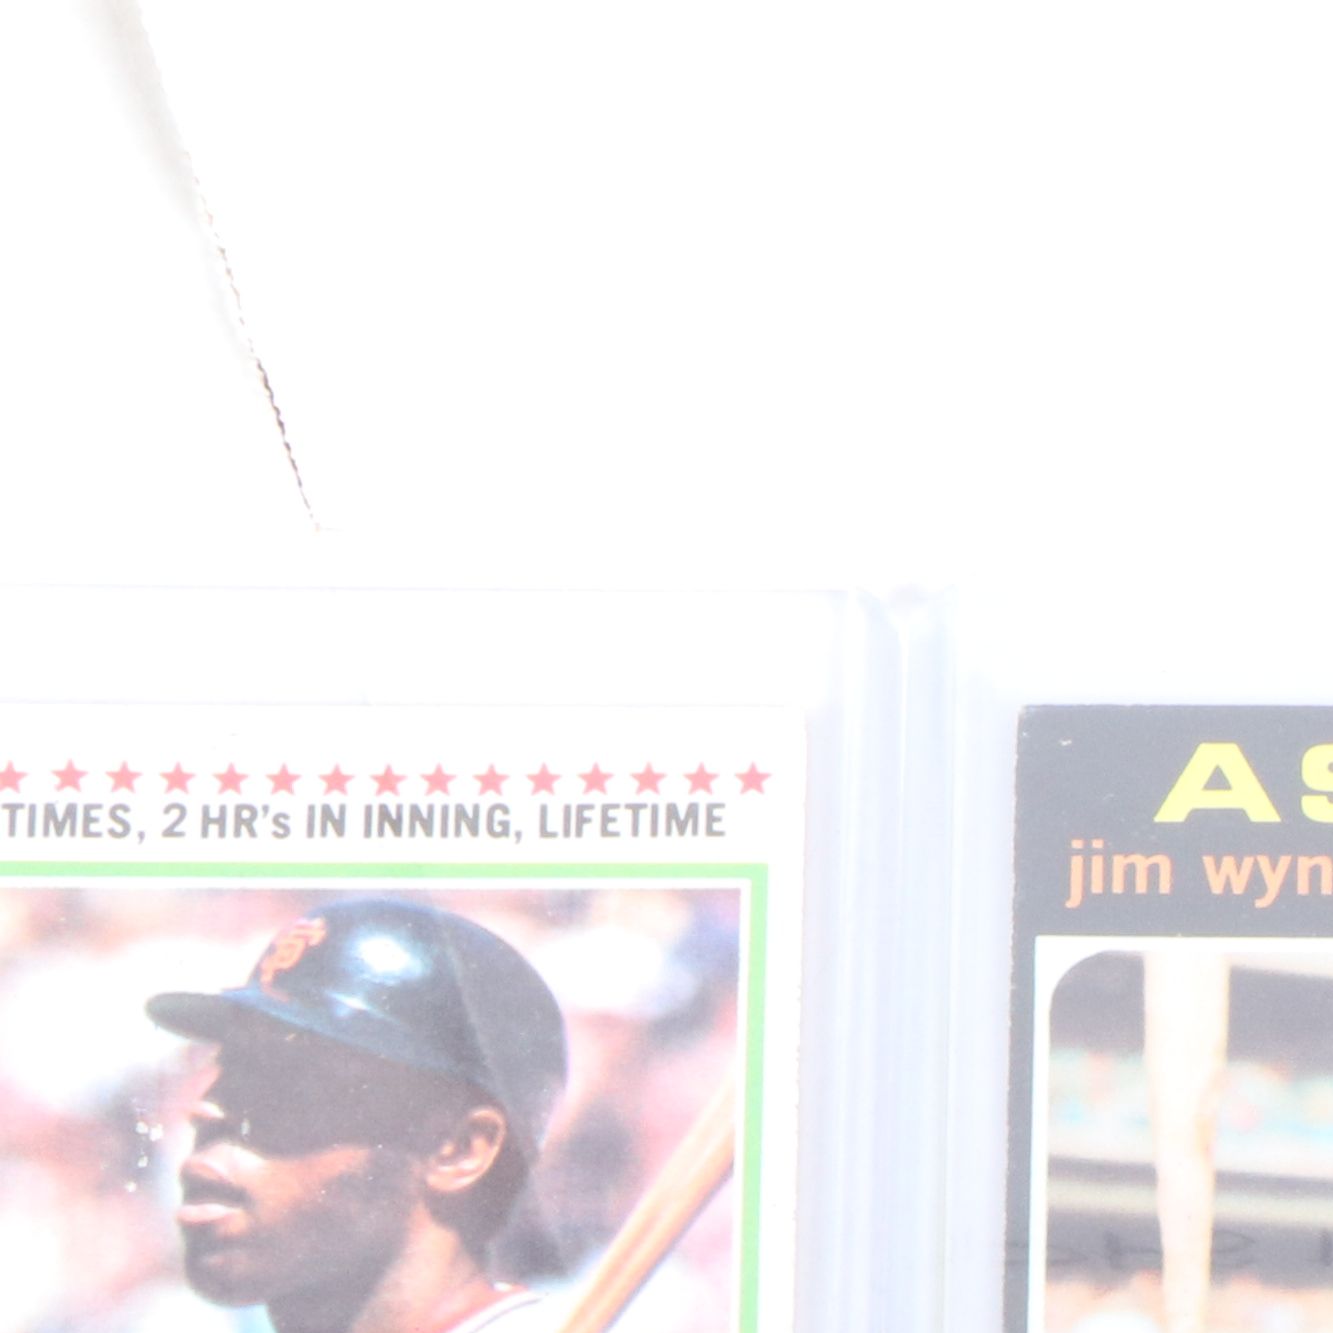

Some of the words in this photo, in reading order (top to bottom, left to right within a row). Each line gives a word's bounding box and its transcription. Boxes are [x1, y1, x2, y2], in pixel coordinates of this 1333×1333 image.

[1, 801, 147, 845] TIMES,
[161, 801, 188, 839] 2
[200, 802, 291, 840] HR's
[306, 803, 347, 839] IN
[363, 803, 524, 845] INNING,
[538, 802, 727, 839] LIFETIME
[1064, 839, 1172, 909] jim
